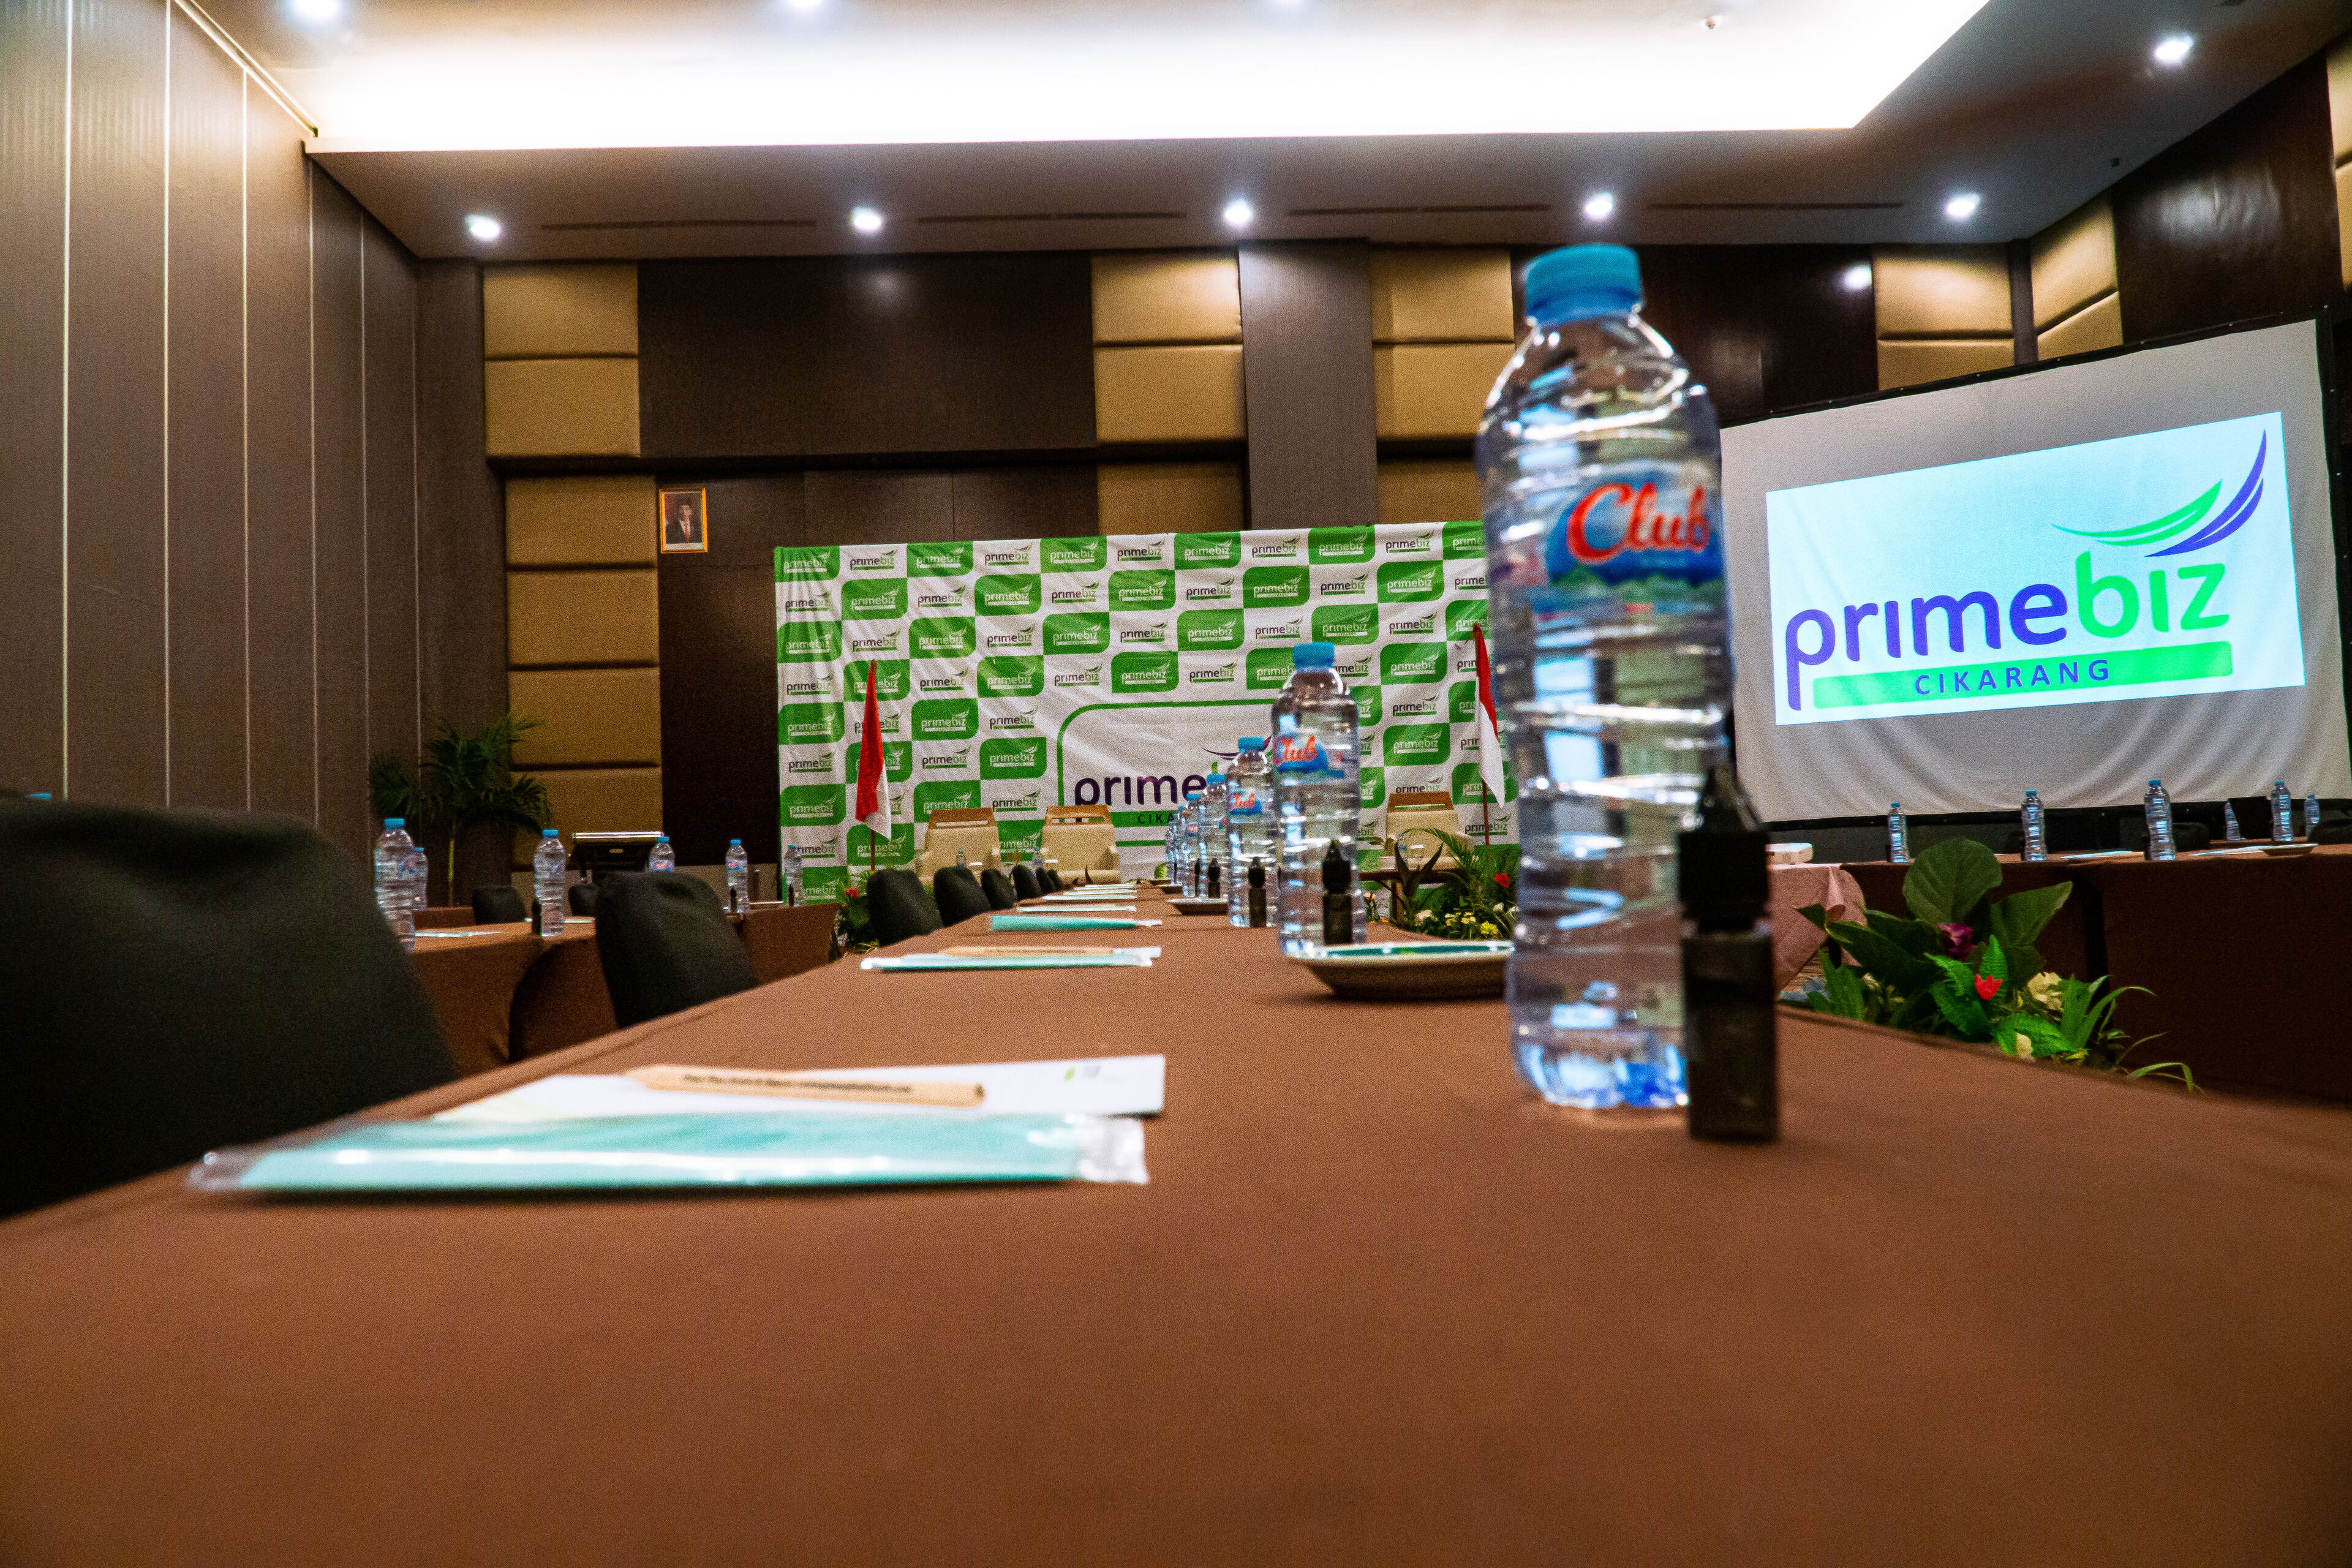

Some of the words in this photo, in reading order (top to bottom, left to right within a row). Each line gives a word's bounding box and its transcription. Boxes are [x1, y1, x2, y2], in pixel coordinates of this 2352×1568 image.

[1566, 481, 1710, 565] Club
[1185, 543, 1229, 559] primebiz
[1253, 541, 1297, 557] primebiz
[1319, 539, 1363, 555] primebiz
[1387, 537, 1431, 553] primebiz
[851, 554, 895, 570] primebiz
[918, 552, 962, 568] primebiz
[984, 550, 1028, 566] primebiz
[1051, 548, 1095, 564] primebiz
[1118, 546, 1163, 562] primebiz
[1254, 582, 1298, 598] primebiz
[1321, 580, 1365, 596] primebiz
[1388, 578, 1432, 594] primebiz
[1455, 577, 1485, 590] prime
[986, 590, 1030, 606] primebiz
[1053, 589, 1097, 605] primebiz
[1120, 586, 1164, 602] primebiz
[1186, 584, 1231, 600] primebiz
[785, 597, 829, 613] primebiz
[851, 595, 895, 611] primebiz
[919, 593, 963, 609] primebiz
[1121, 627, 1165, 643] primebiz
[1188, 625, 1232, 641] primebiz
[1255, 623, 1299, 639] primebiz
[1322, 620, 1366, 636] primebiz
[1390, 619, 1434, 635] primebiz
[1784, 552, 2230, 711] primebiz
[853, 636, 897, 652] primebiz
[920, 633, 964, 649] primebiz
[987, 631, 1031, 647] primebiz
[1054, 629, 1098, 645] primebiz
[1189, 666, 1234, 682] primebiz
[1257, 662, 1294, 681] primeb
[1391, 659, 1435, 675] primebiz
[921, 674, 965, 690] primebiz
[988, 672, 1032, 688] primebiz
[1055, 670, 1099, 686] primebiz
[1122, 668, 1166, 684] primebiz
[1915, 658, 2111, 696] CIKARANG
[787, 679, 831, 695] primebiz
[1393, 700, 1437, 716] primebiz
[922, 715, 967, 731] primebiz
[989, 713, 1033, 729] primebiz
[1394, 737, 1438, 753] primebiz
[789, 756, 833, 772] primebiz
[923, 754, 967, 770] primebiz
[990, 751, 1035, 767] primebiz
[992, 795, 1036, 811] primebiz
